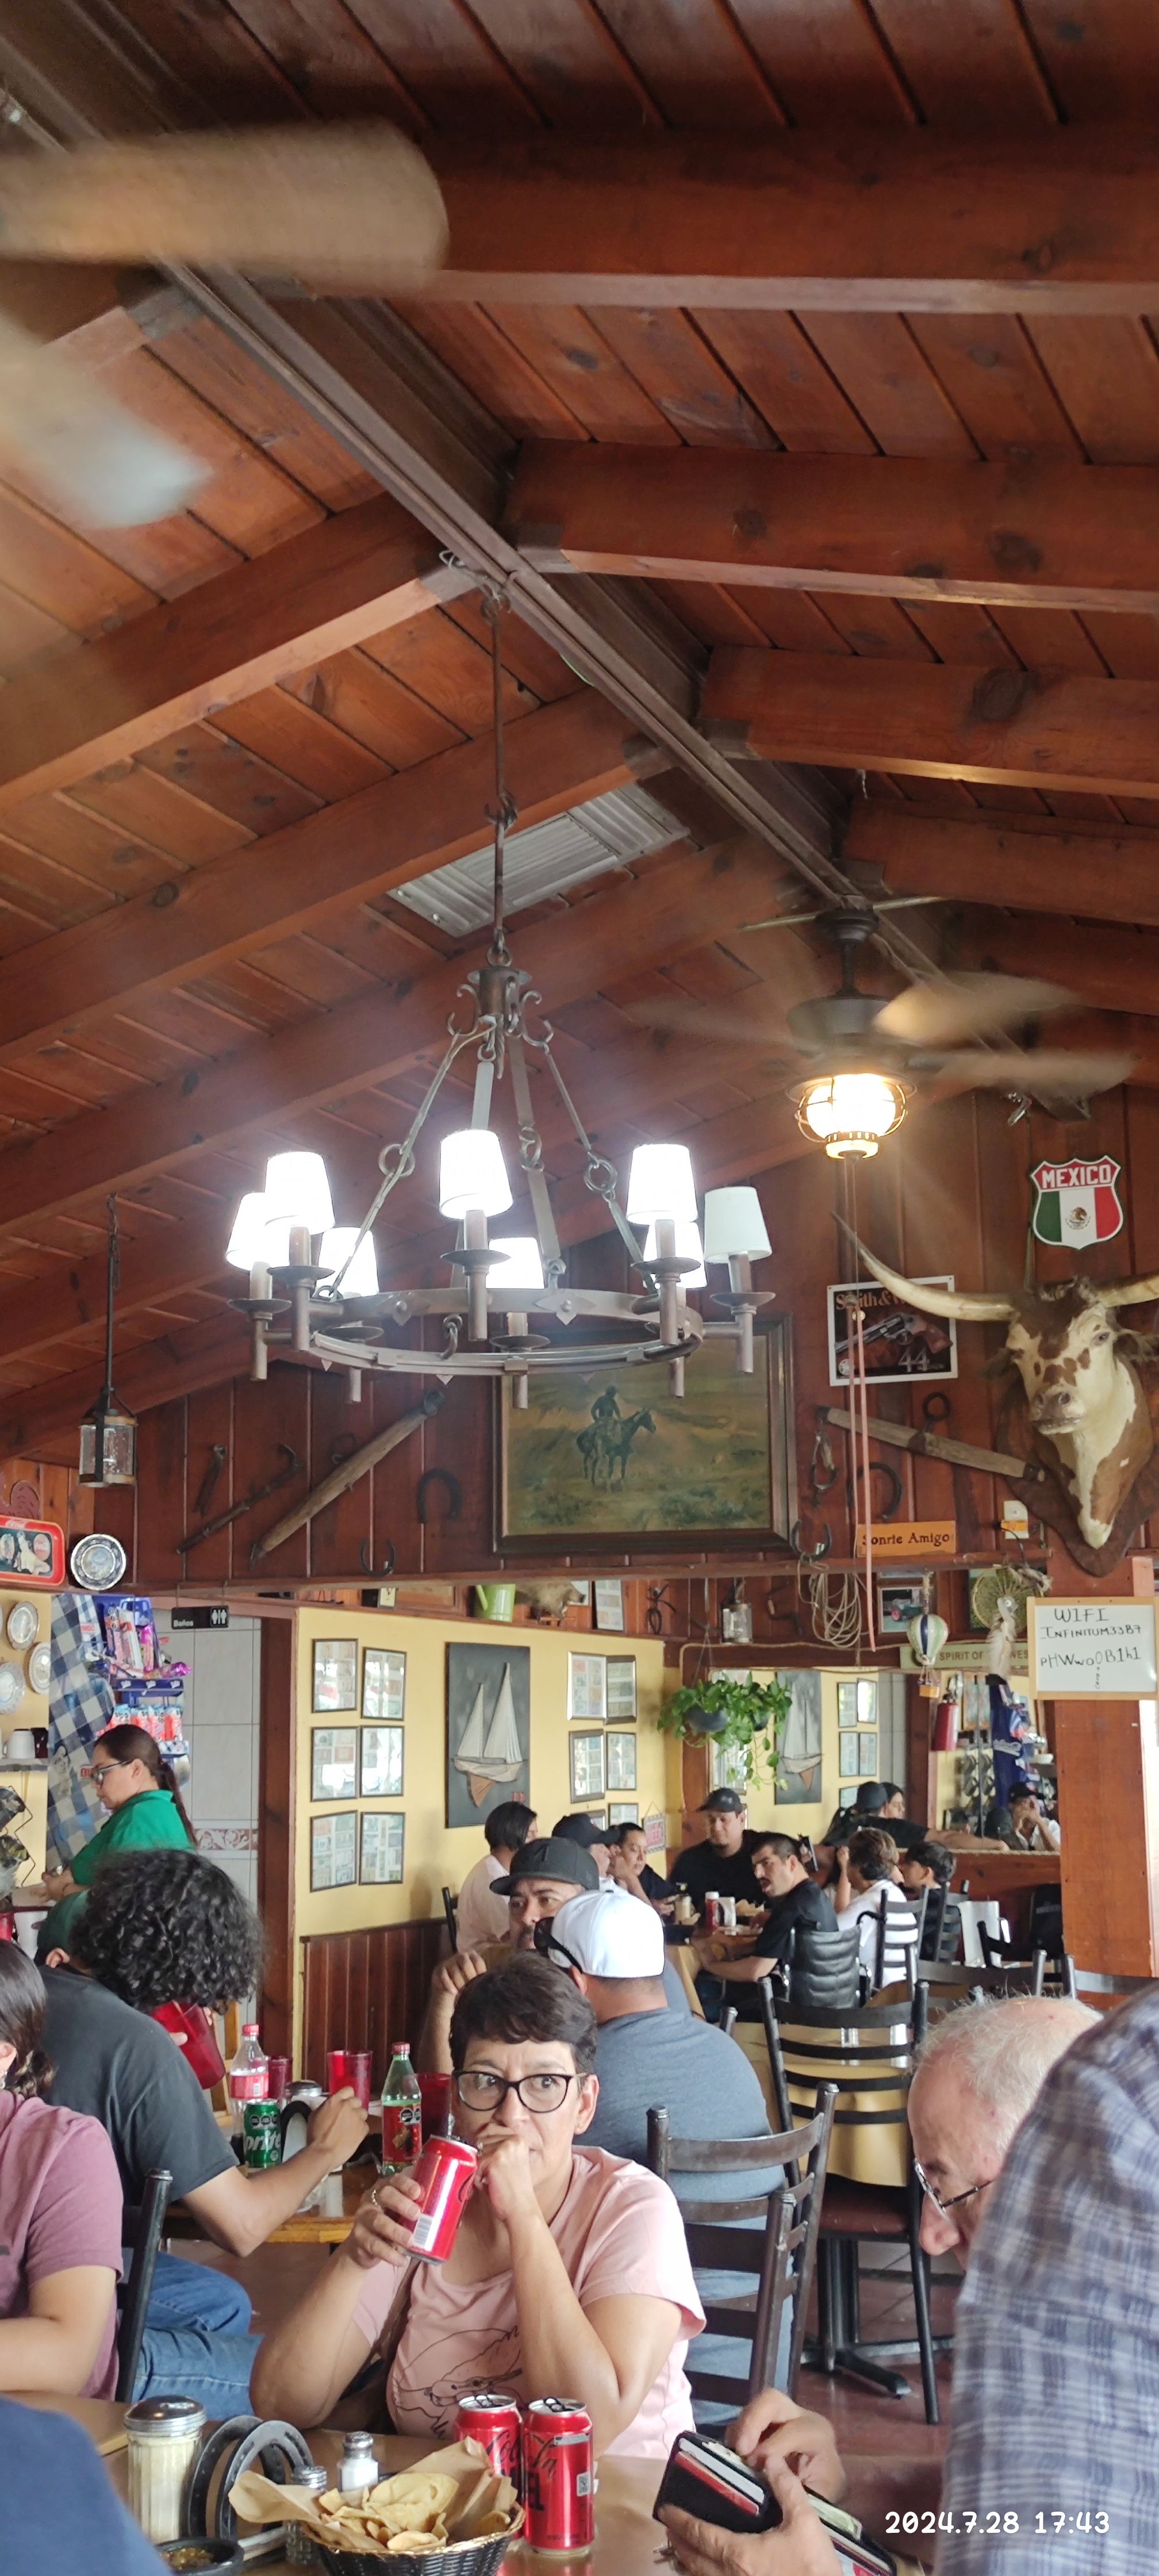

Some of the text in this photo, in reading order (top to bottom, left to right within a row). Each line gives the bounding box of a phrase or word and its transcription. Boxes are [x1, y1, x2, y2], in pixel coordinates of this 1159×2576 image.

[1042, 1164, 1111, 1189] MEXICO
[836, 1291, 877, 1310] Sith
[898, 1347, 930, 1372] 44
[908, 1533, 950, 1547] Amigo
[1054, 1608, 1110, 1623] WIFI
[939, 1652, 969, 1661] SPIRIT
[972, 1651, 984, 1660] OF
[246, 2129, 281, 2152] prite
